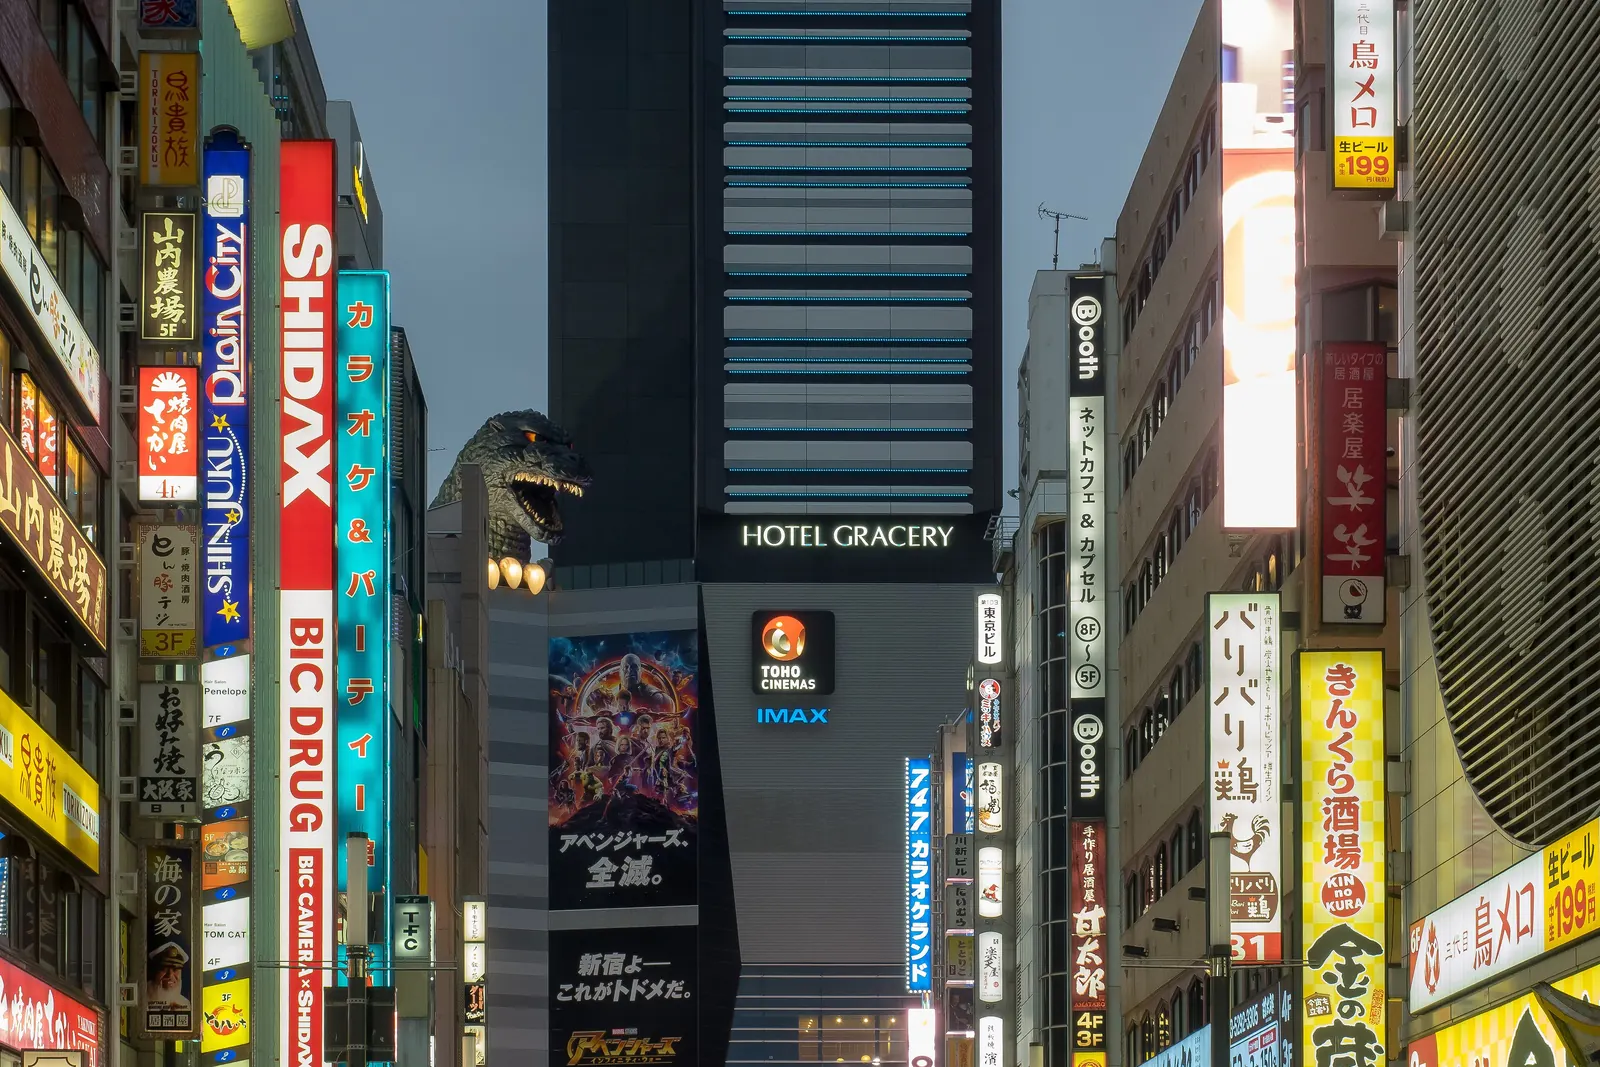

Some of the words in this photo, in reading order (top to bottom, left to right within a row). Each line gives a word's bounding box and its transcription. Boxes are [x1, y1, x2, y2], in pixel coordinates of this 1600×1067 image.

[1358, 3, 1369, 36] 三代目
[1349, 40, 1379, 130] 鳥メロ
[1339, 141, 1388, 153] 生ビール
[1345, 155, 1389, 176] 199
[150, 217, 186, 322] 山内農場
[160, 324, 178, 337] 5F
[1071, 295, 1103, 380] Booth
[284, 223, 332, 508] SHIDAX
[1334, 367, 1374, 381] 居酒屋
[144, 399, 167, 471] さかい
[168, 392, 191, 455] 焼肉屋
[1342, 386, 1365, 459] 居楽屋
[1078, 407, 1097, 503] ネットカフェ
[155, 478, 181, 499] 4F
[0, 441, 92, 622] 山内農場
[206, 437, 243, 595] SHINJUKU
[1080, 514, 1095, 529] &
[743, 525, 828, 548] HOTEL
[833, 525, 954, 549] GRACERY
[1079, 536, 1096, 603] カプセル
[154, 633, 184, 652] 3F
[984, 606, 996, 658] 東京ビル
[1080, 623, 1095, 637] 8F
[290, 618, 323, 693] BIC
[761, 666, 801, 677] TOHO
[204, 688, 247, 698] Penelope
[761, 680, 816, 691] CINEMAS
[1081, 670, 1096, 684] 5F
[154, 685, 186, 775] お好み焼
[209, 715, 221, 723] 7F
[757, 709, 828, 724] IMAX
[290, 707, 323, 833] DRUG
[1073, 713, 1104, 798] Booth
[1323, 663, 1361, 871] きんくら酒場
[64, 788, 98, 840] TORIKIZOKU
[911, 768, 929, 832] 747
[204, 833, 214, 842] 5F
[298, 853, 313, 888] BIC
[586, 854, 662, 888] 全滅。
[1082, 825, 1095, 902] 手作り居酒屋
[1548, 831, 1594, 890] 生ビール
[153, 855, 183, 935] 海の家
[1327, 875, 1355, 888] KIN
[1334, 888, 1352, 897] no
[910, 840, 930, 984] カラオケランド
[1325, 897, 1362, 912] KURA
[1554, 878, 1587, 939] 199
[204, 931, 225, 939] TOM
[298, 892, 313, 978] CAMERA
[403, 912, 420, 951] TFC
[1411, 926, 1421, 954] 6F
[1473, 881, 1535, 972] 鳥メロ
[207, 957, 220, 967] 4F
[1073, 904, 1105, 999] 甘太郎
[221, 994, 232, 1002] 3F
[557, 979, 691, 1002] これがトドメだ。
[1282, 990, 1292, 1022] 4F
[1077, 1012, 1104, 1028] 4F
[1077, 1031, 1104, 1047] 3F
